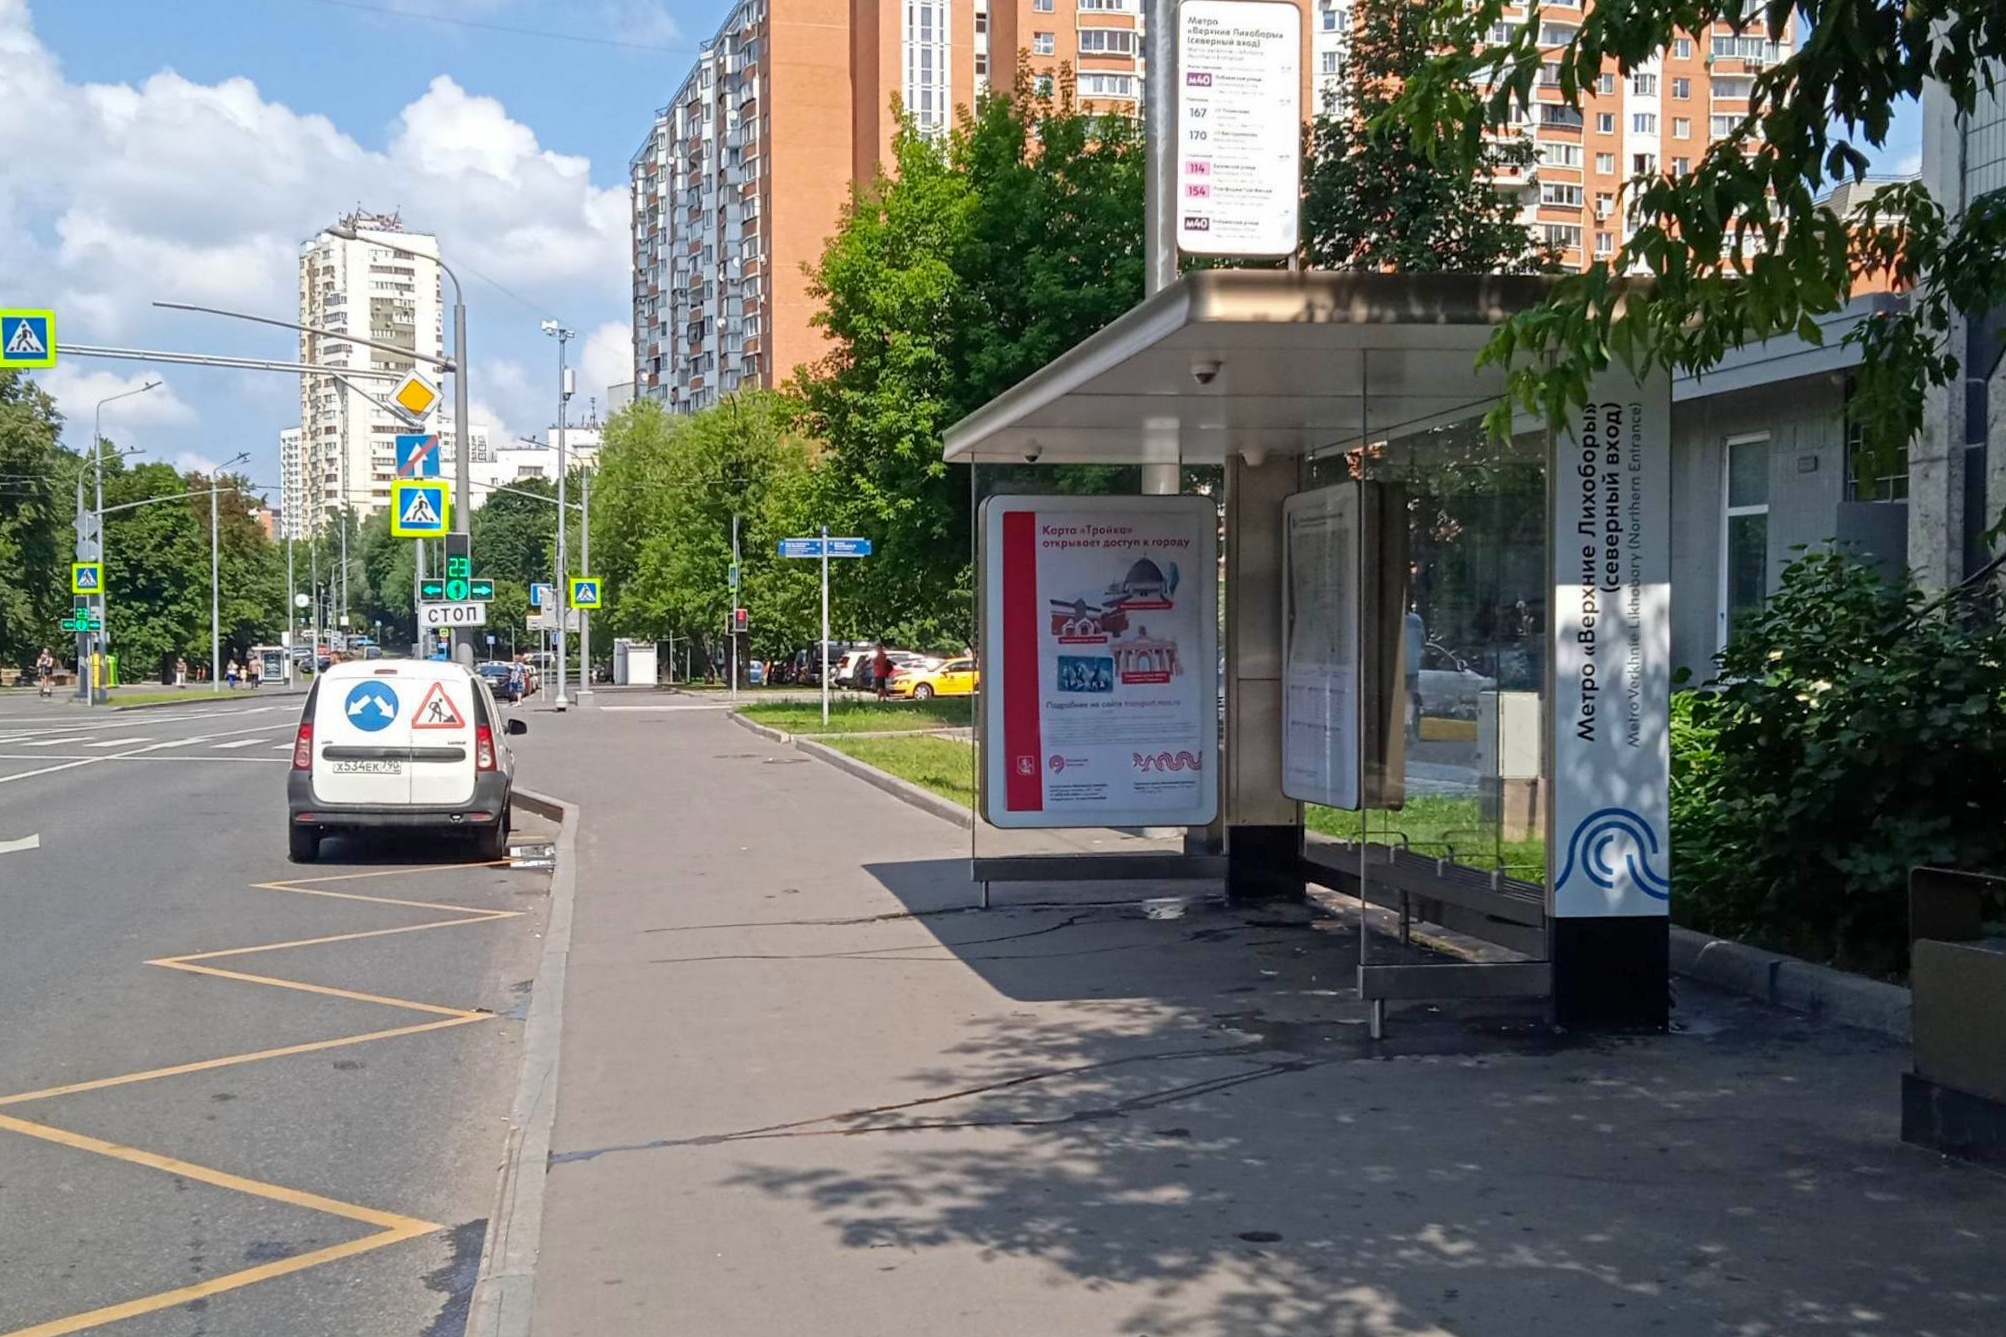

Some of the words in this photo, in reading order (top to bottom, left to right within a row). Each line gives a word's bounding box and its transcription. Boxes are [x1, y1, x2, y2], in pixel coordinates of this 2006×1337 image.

[1187, 16, 1219, 27] Метро
[1187, 26, 1231, 36] «Верхние
[1187, 37, 1234, 46] (северный
[1236, 39, 1261, 48] вход)
[1189, 107, 1207, 118] 167
[1189, 130, 1207, 141] 170
[1190, 163, 1205, 174] 114
[1189, 186, 1206, 196] 154
[1600, 403, 1623, 465] вход)
[1628, 403, 1643, 472] Entrance)
[1577, 403, 1600, 537] Лихоборы»
[1627, 478, 1642, 549] (Northern
[1042, 525, 1077, 537] Карта
[1080, 525, 1133, 537] «Тройка»
[1600, 473, 1623, 593] (северный
[1042, 540, 1100, 550] открывает
[1103, 539, 1140, 549] доступ
[1151, 538, 1190, 549] городу
[448, 557, 469, 577] 23
[1578, 545, 1600, 656] «Верхние
[1627, 553, 1642, 628] Likhobory
[428, 606, 477, 623] СТОП
[1627, 632, 1641, 699] Verkhnie
[1577, 662, 1600, 742] Метро
[1627, 703, 1640, 748] Metro
